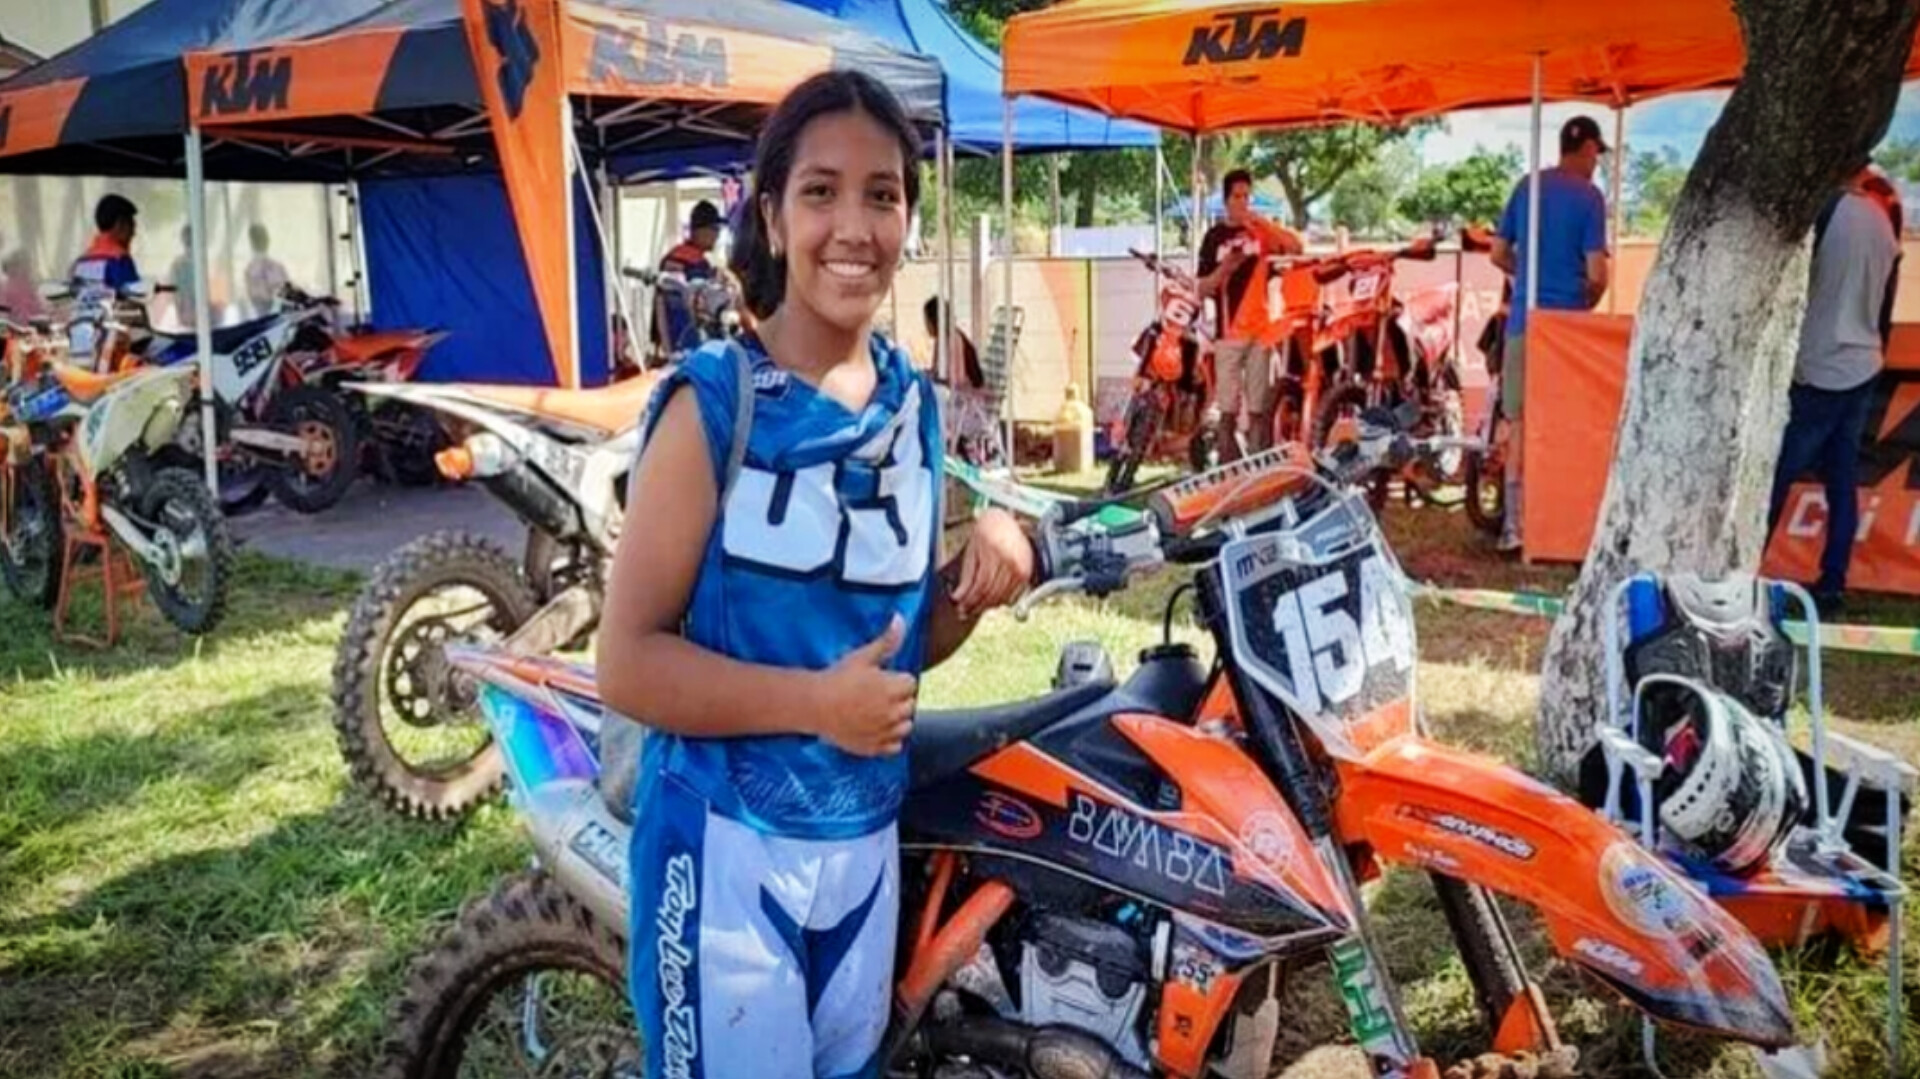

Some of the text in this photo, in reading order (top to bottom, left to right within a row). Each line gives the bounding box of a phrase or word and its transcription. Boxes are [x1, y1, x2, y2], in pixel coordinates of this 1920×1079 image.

[591, 12, 730, 87] KTM
[1182, 8, 1306, 66] KTM
[200, 48, 292, 117] KTM
[1272, 556, 1413, 714] 154
